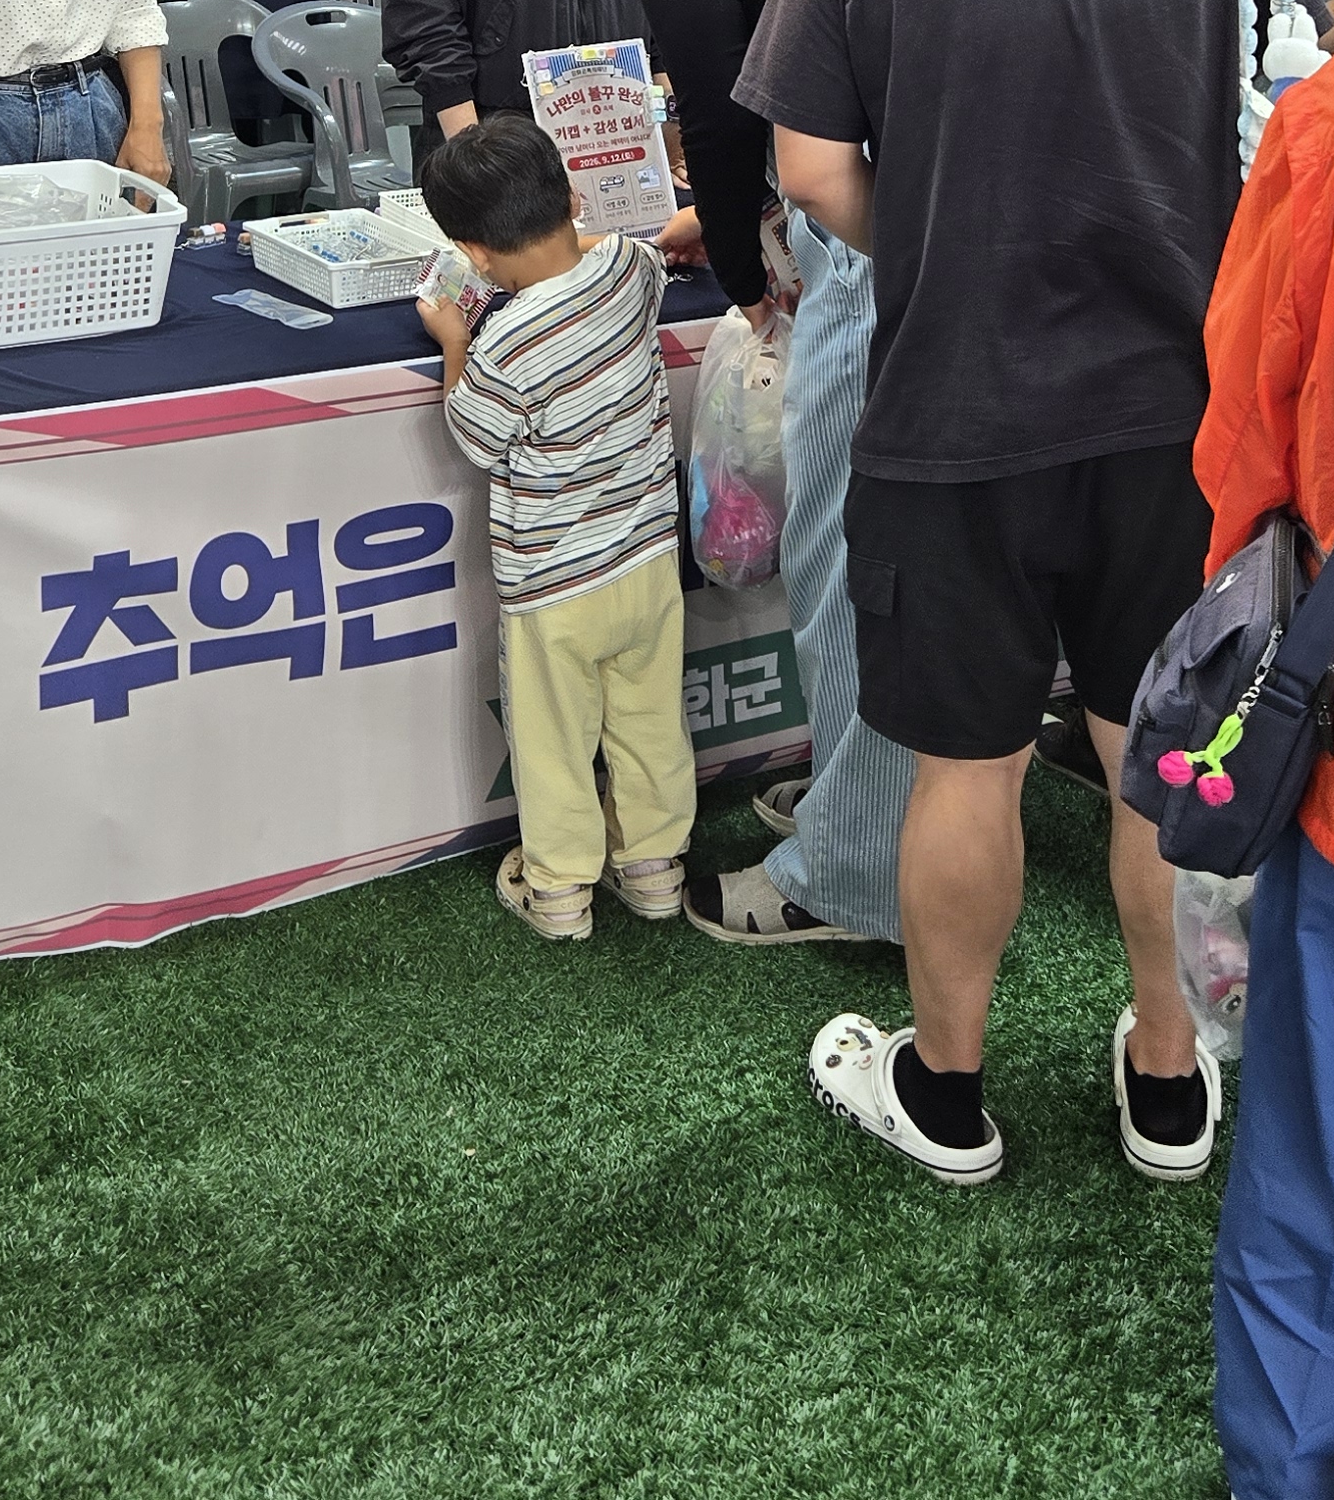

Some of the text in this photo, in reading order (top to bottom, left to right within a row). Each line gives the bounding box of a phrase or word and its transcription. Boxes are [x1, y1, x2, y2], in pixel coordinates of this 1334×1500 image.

[546, 85, 644, 117] 나만의 볼꾸 완성
[555, 124, 581, 140] 키캡
[593, 118, 618, 135] 감성
[621, 114, 645, 131] 엽서
[37, 501, 458, 724] 추억은
[683, 651, 782, 733] 화군
[807, 1068, 866, 1131] crocs
